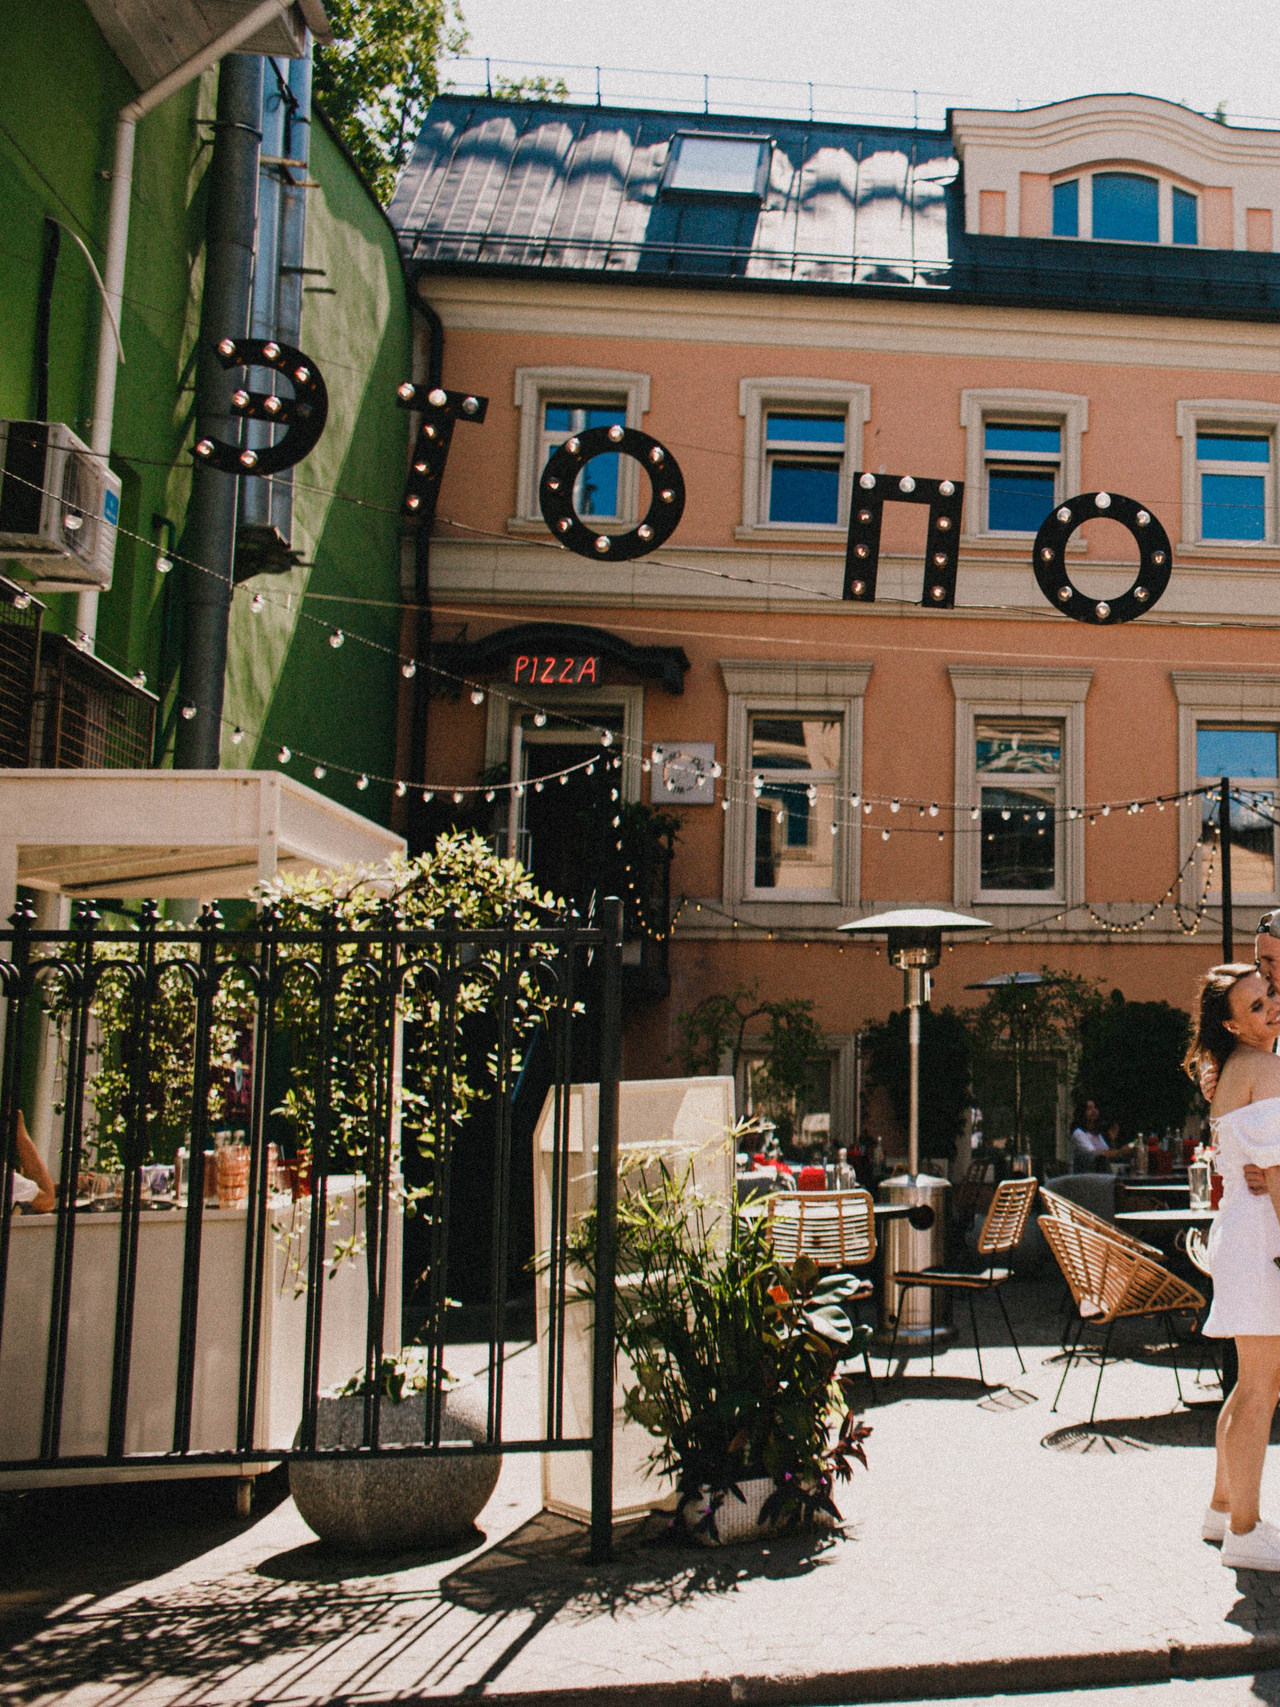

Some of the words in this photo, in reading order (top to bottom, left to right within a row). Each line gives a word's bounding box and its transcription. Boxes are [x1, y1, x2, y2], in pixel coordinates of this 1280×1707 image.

[189, 338, 687, 562] ЭТО
[843, 471, 1173, 625] ПО
[514, 655, 596, 684] PIZZA
